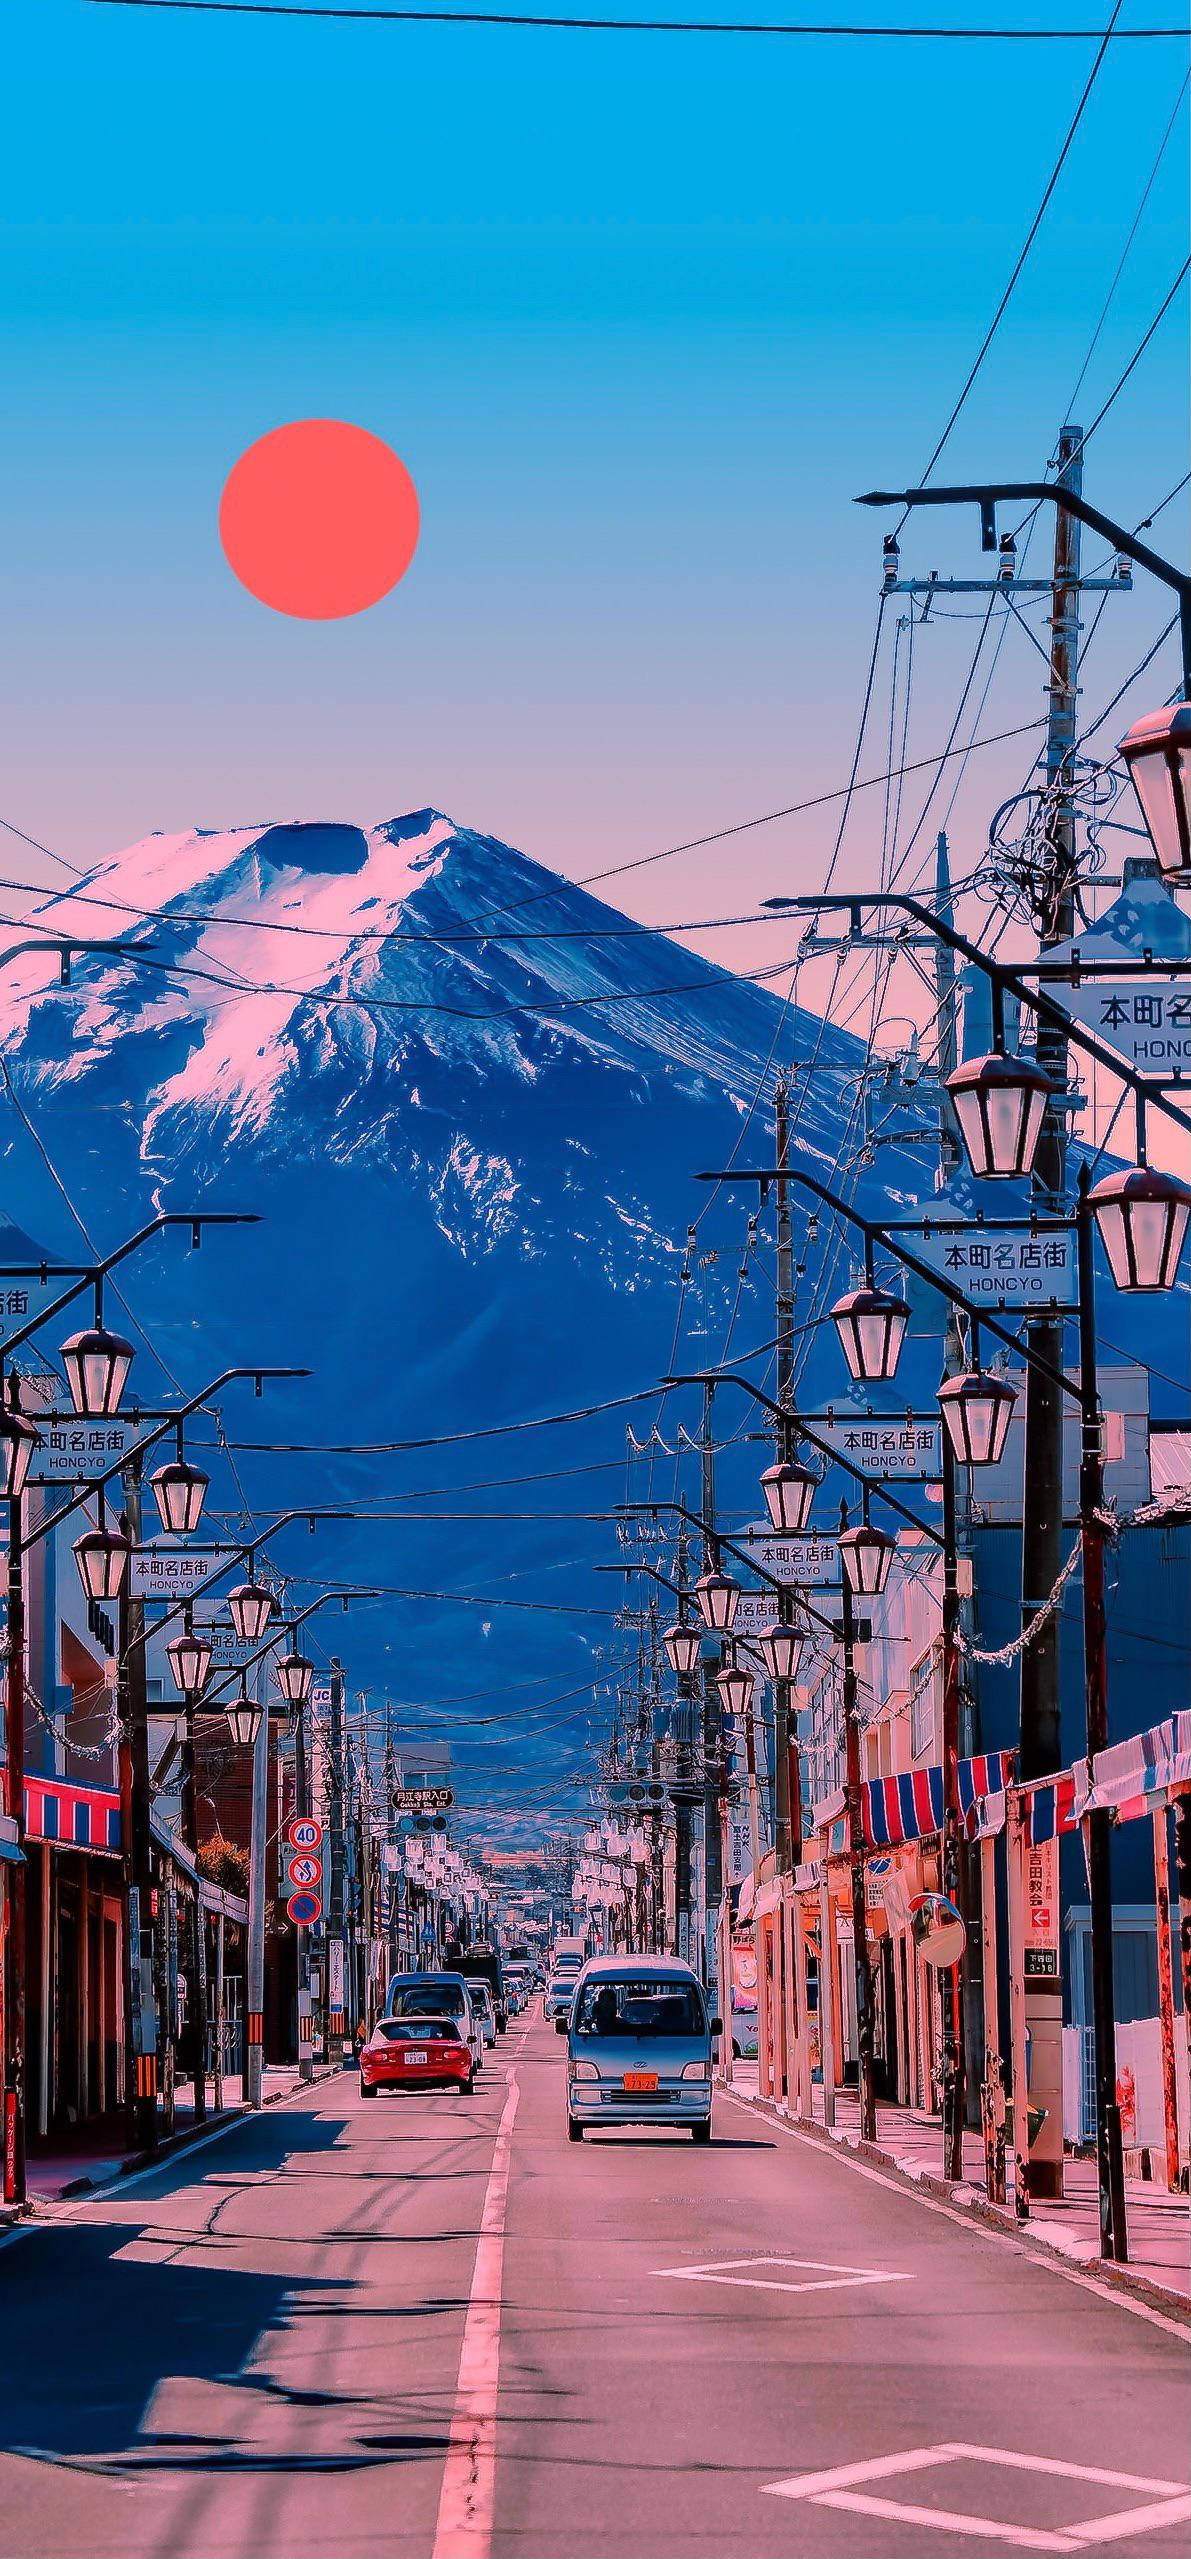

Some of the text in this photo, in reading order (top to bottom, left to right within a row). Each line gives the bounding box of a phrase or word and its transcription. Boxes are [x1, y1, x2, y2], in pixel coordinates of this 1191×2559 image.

[944, 1242, 1067, 1271] 本町名店街
[969, 1278, 1042, 1291] HONCYO
[0, 1289, 28, 1315] 街
[843, 1431, 933, 1451] 本町名店街
[50, 1457, 105, 1468] HONCYO
[862, 1456, 916, 1467] HONCYO
[761, 1545, 834, 1563] 本町名店街
[136, 1560, 208, 1576] 本町名店街
[776, 1567, 820, 1576] HONCYO
[150, 1581, 193, 1589] HONCYO
[203, 1634, 258, 1648] 町名店街
[297, 1827, 315, 1842] 40
